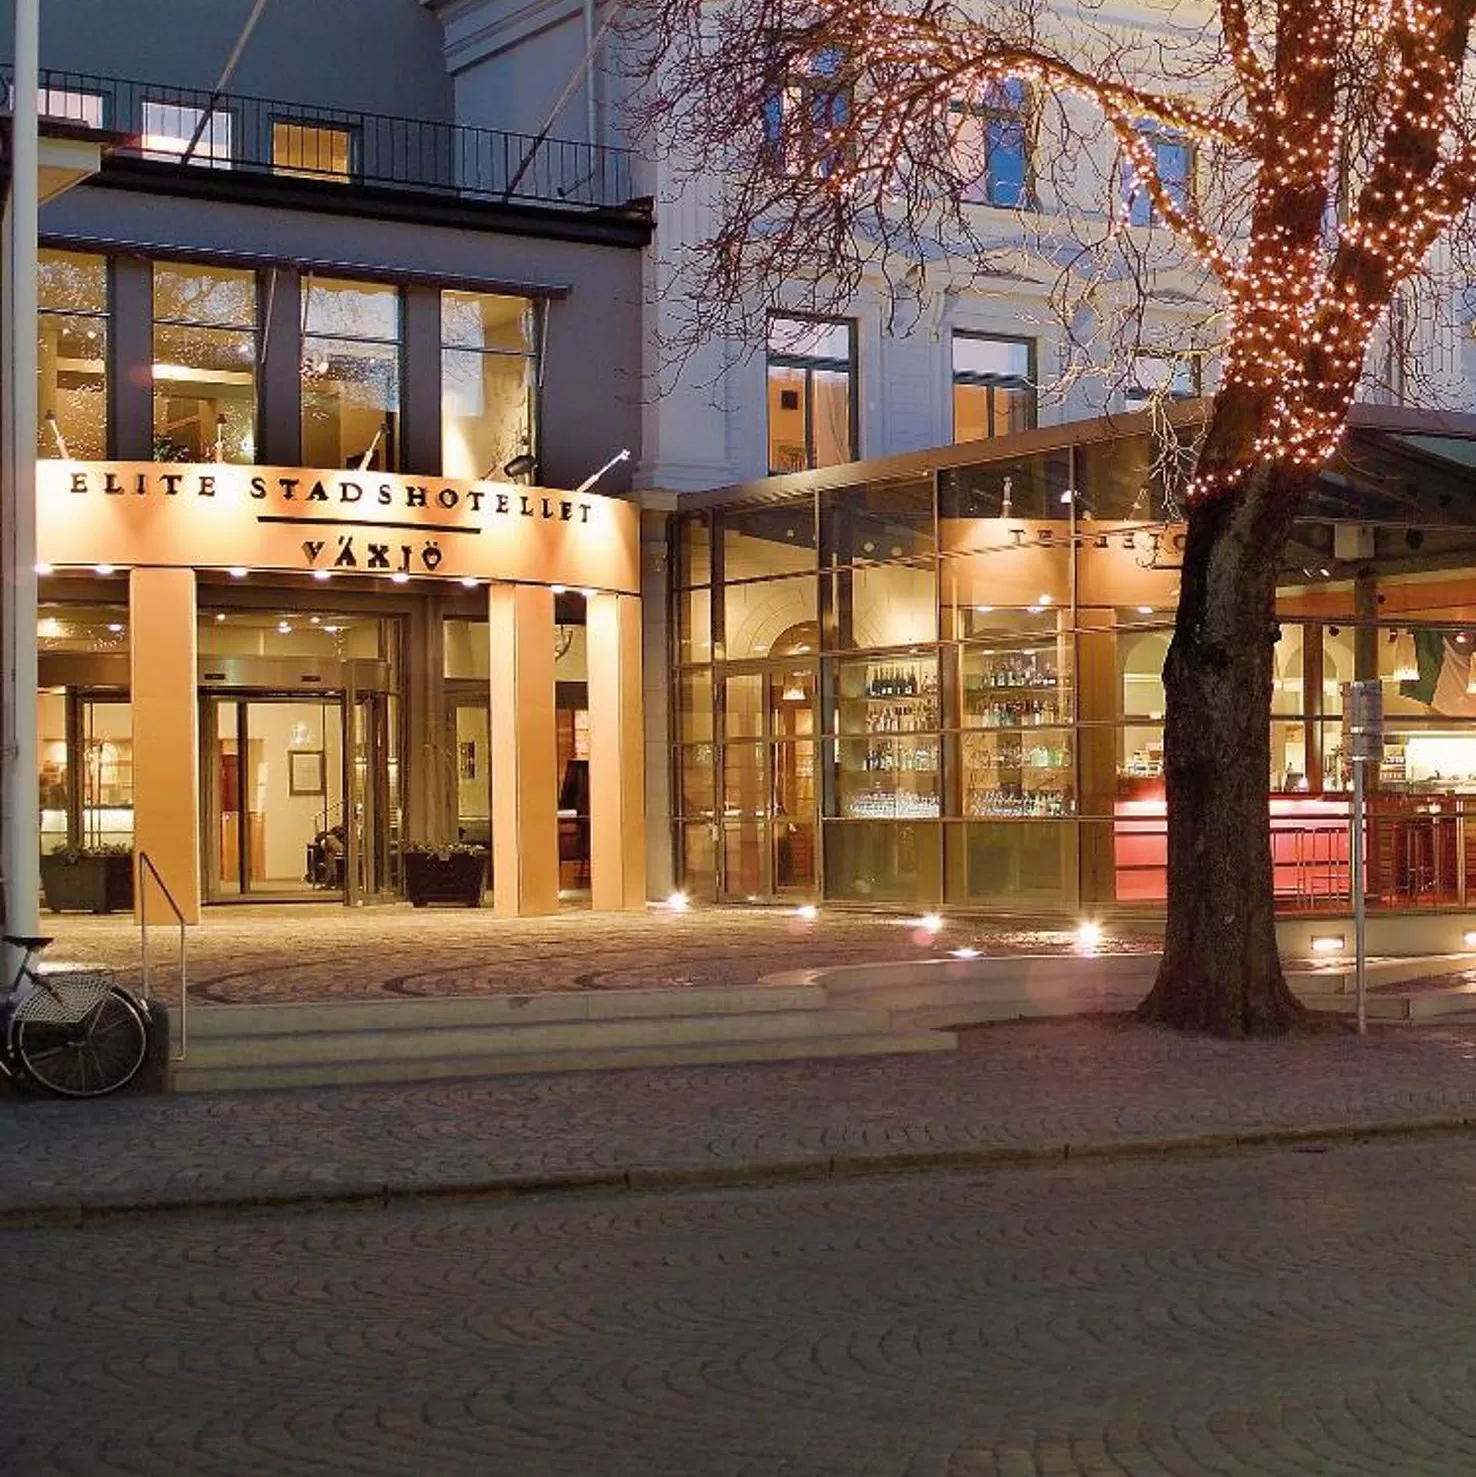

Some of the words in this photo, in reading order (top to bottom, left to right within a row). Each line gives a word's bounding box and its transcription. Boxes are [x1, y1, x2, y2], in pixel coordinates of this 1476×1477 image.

[71, 473, 216, 497] ELITE
[249, 477, 592, 523] STADSHOTELLET
[301, 535, 443, 573] VÄXJÖ
